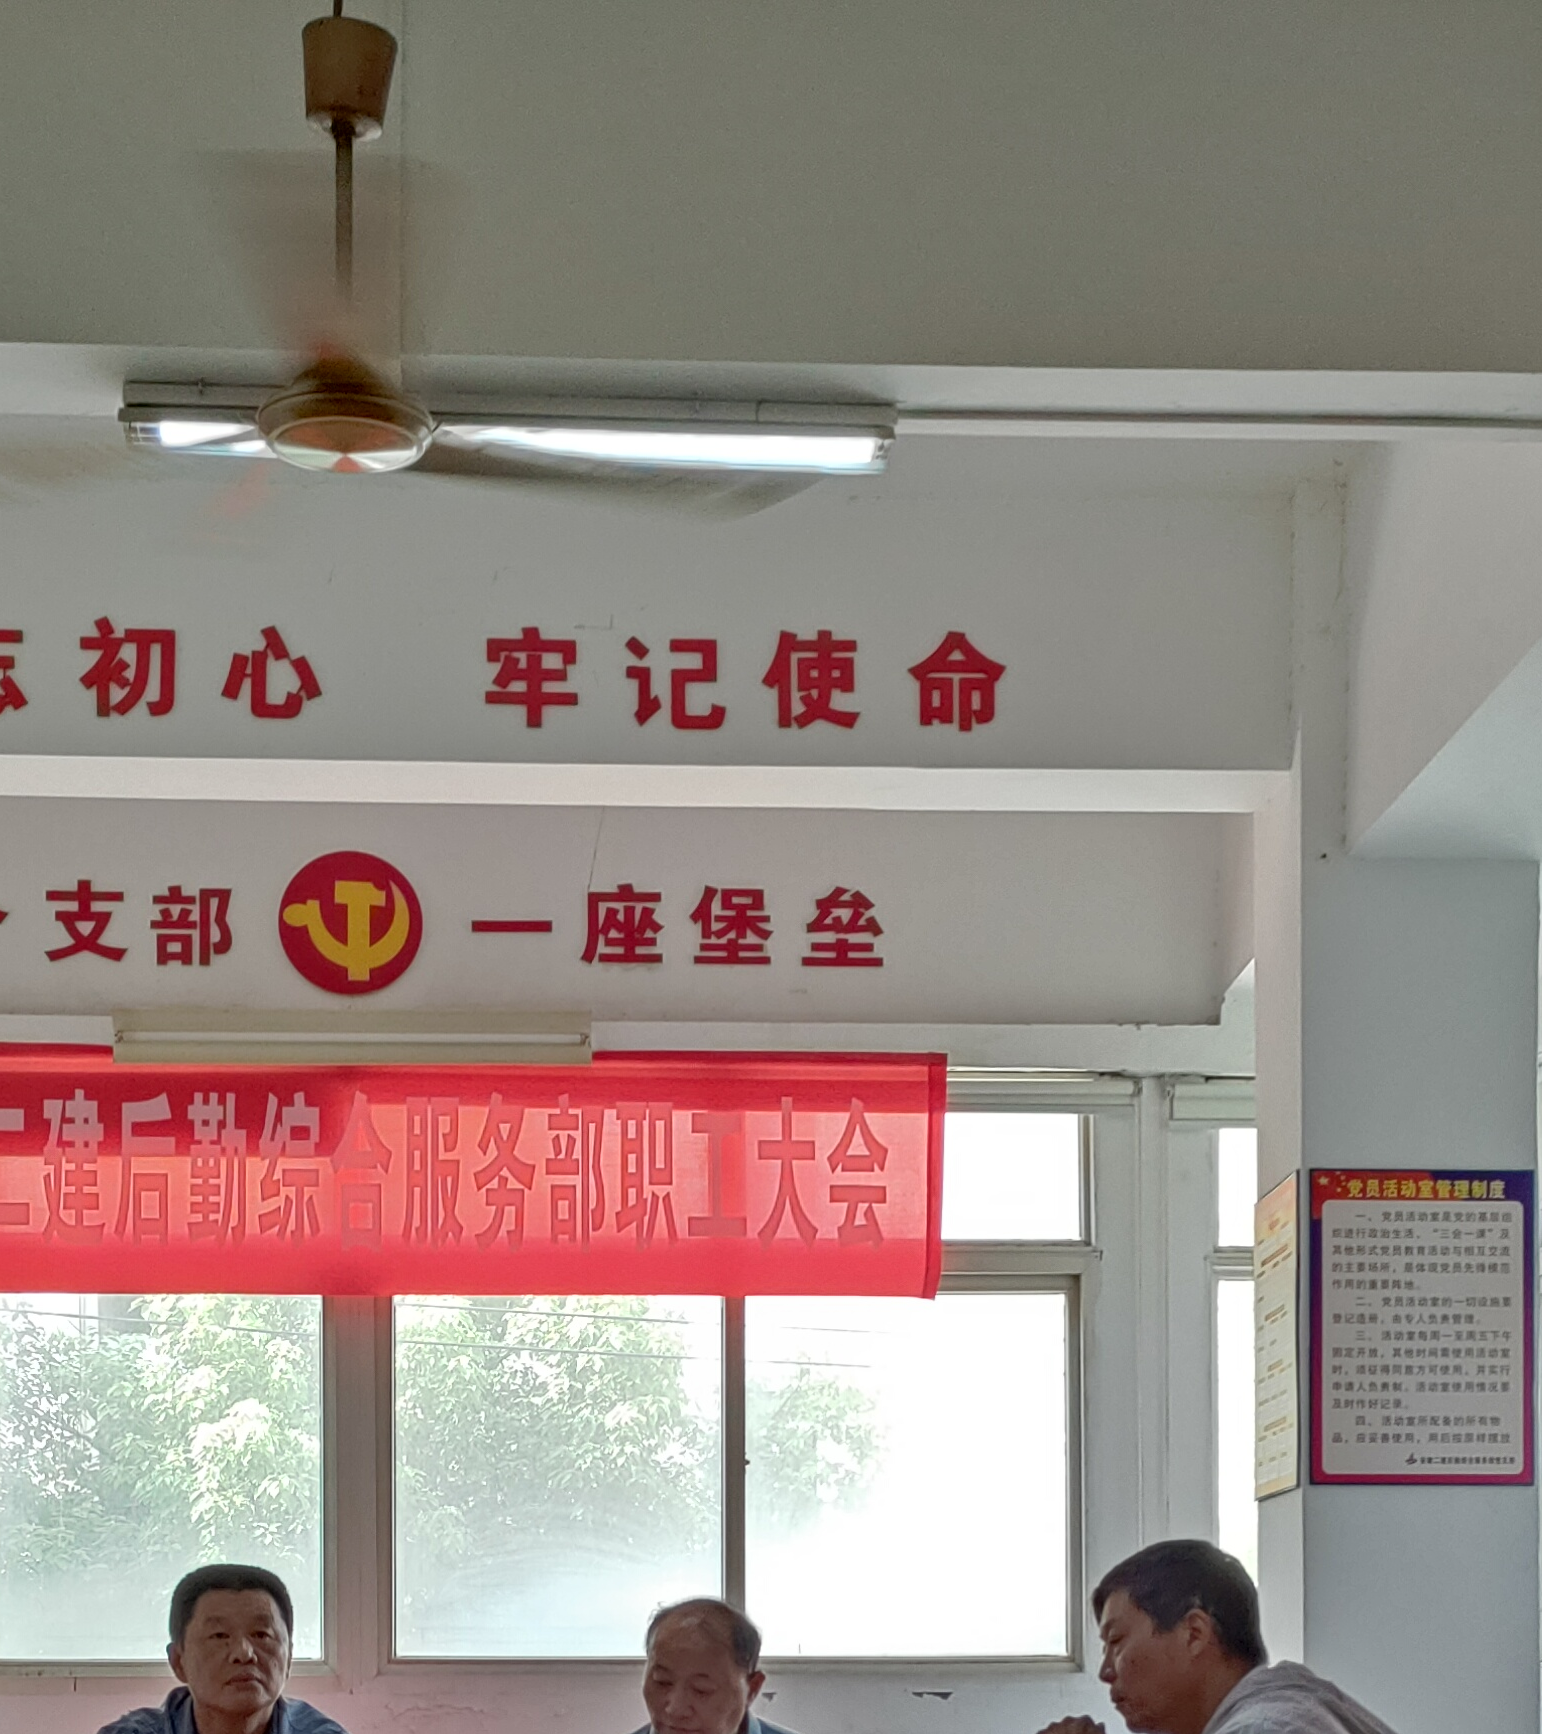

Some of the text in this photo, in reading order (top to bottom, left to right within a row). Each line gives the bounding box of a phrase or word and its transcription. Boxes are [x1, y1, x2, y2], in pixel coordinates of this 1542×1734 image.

[485, 626, 1008, 732] 牢记使命
[471, 884, 887, 969] 一座堡垒
[1346, 1178, 1506, 1200] 党员活动室管理制度
